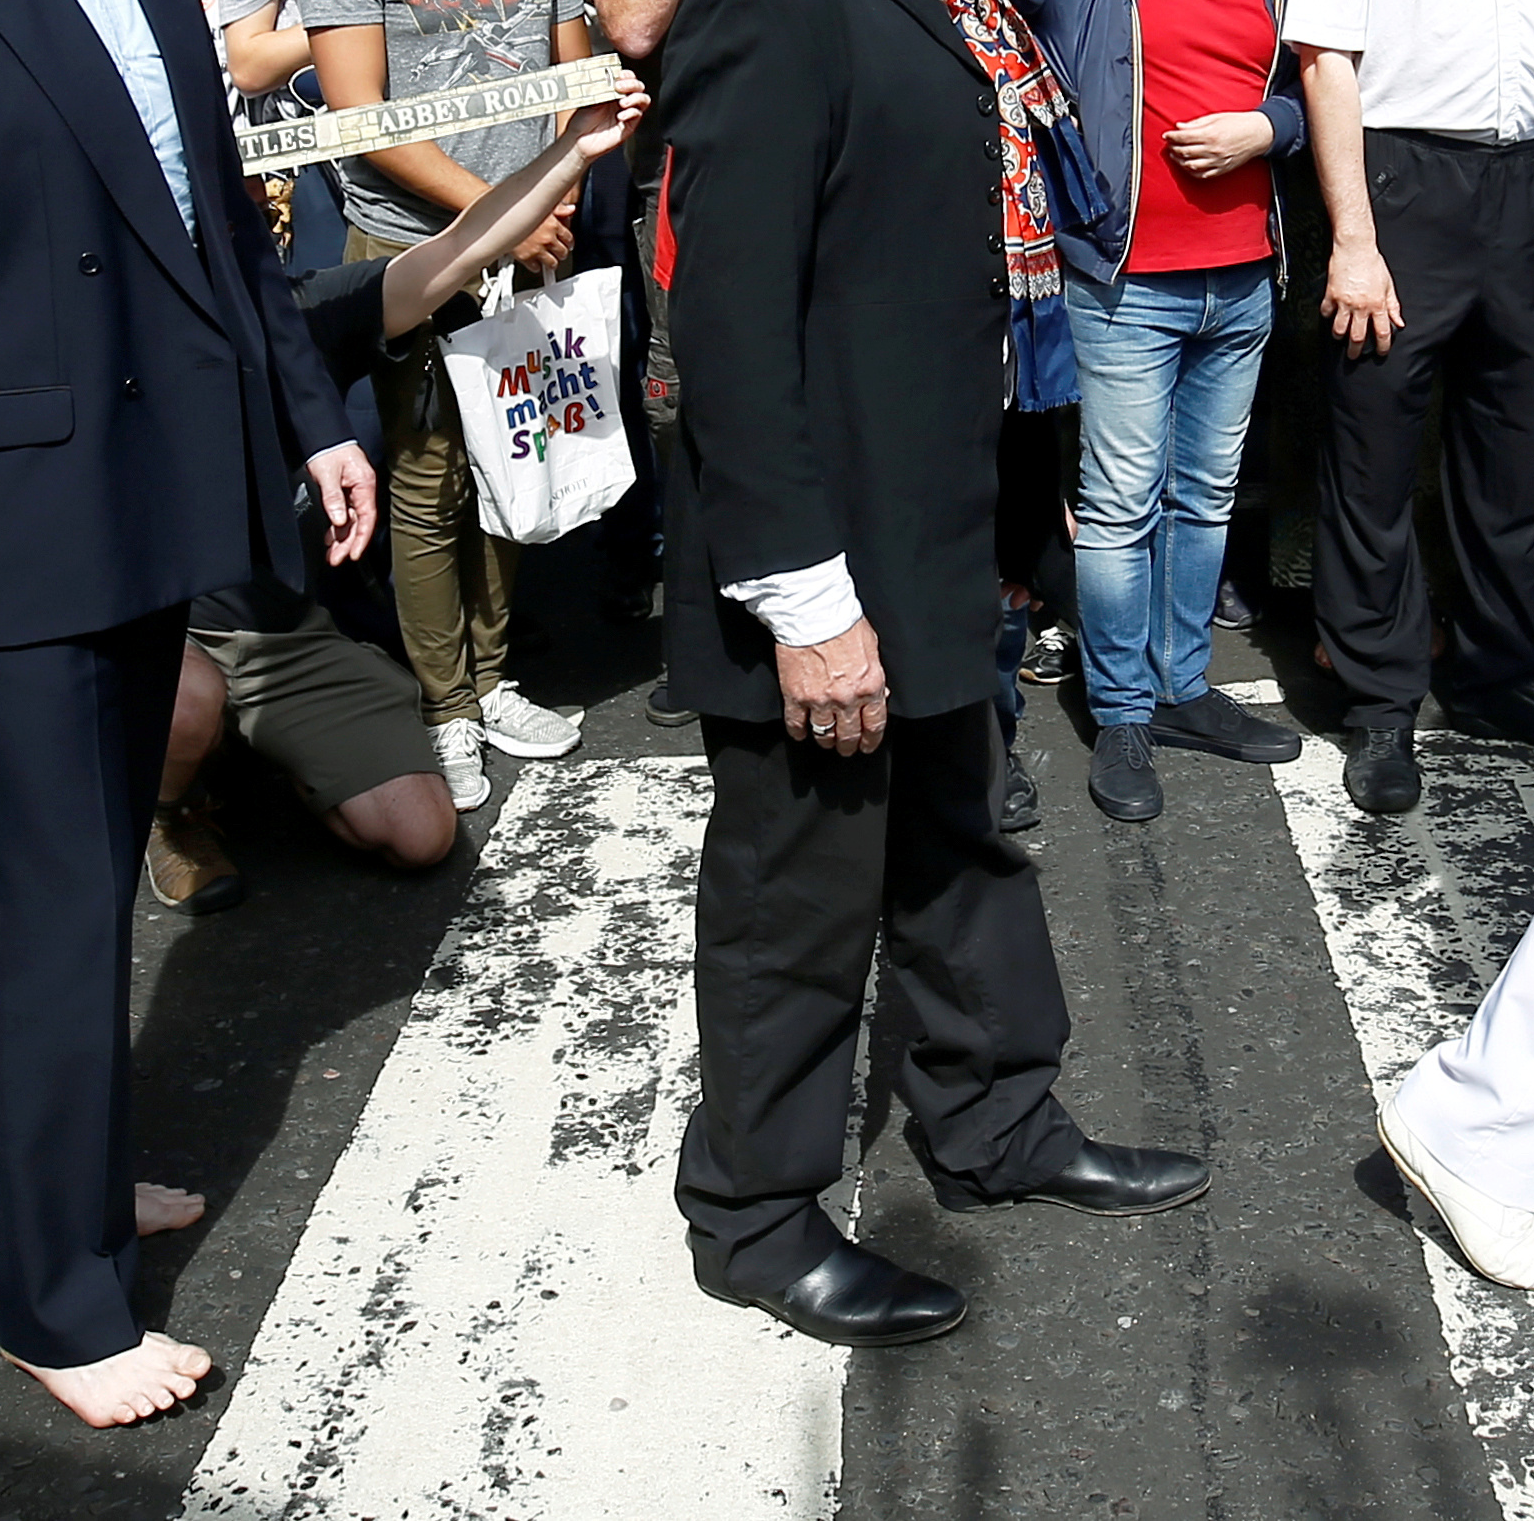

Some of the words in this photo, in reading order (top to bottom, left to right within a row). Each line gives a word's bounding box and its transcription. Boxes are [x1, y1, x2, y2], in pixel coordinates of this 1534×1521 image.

[238, 125, 318, 161] TLES
[379, 95, 472, 136] ABBEY
[484, 77, 561, 114] ROAD
[497, 327, 587, 399] Musik
[506, 362, 599, 429] macht
